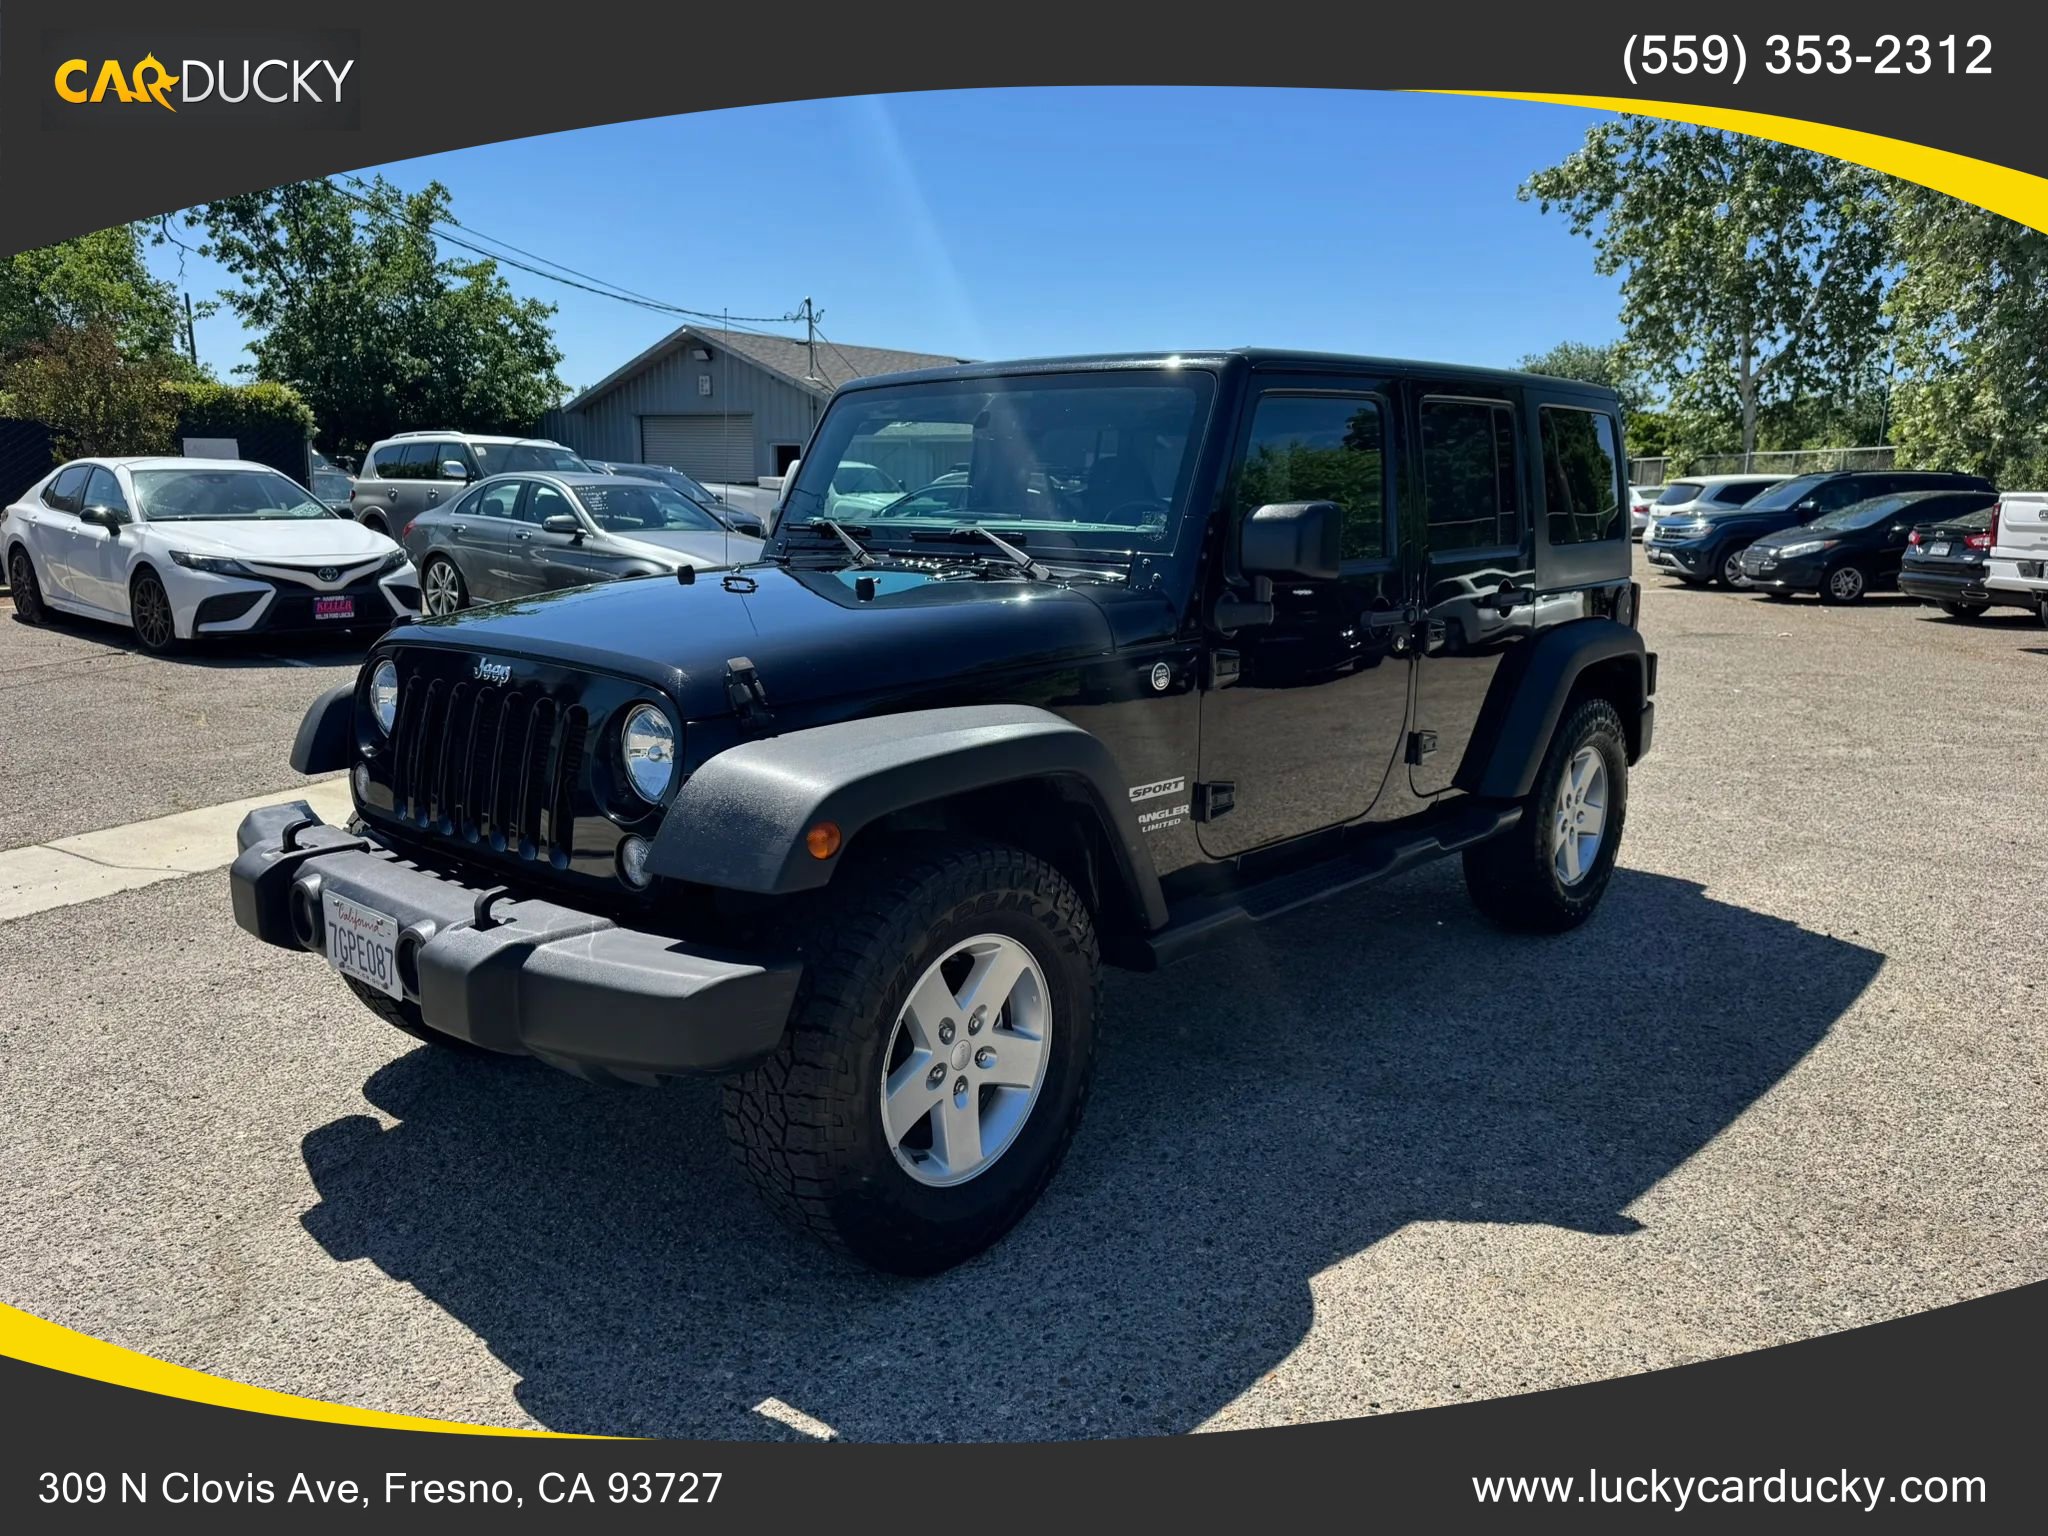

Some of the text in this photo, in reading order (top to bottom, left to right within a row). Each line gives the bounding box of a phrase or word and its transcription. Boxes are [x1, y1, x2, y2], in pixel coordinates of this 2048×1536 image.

[473, 657, 511, 687] Jeep
[1132, 781, 1181, 797] SPORT
[1138, 804, 1190, 824] ANGLER
[1142, 818, 1181, 833] LIMITED
[338, 902, 379, 932] California
[328, 921, 394, 986] 7GPE087
